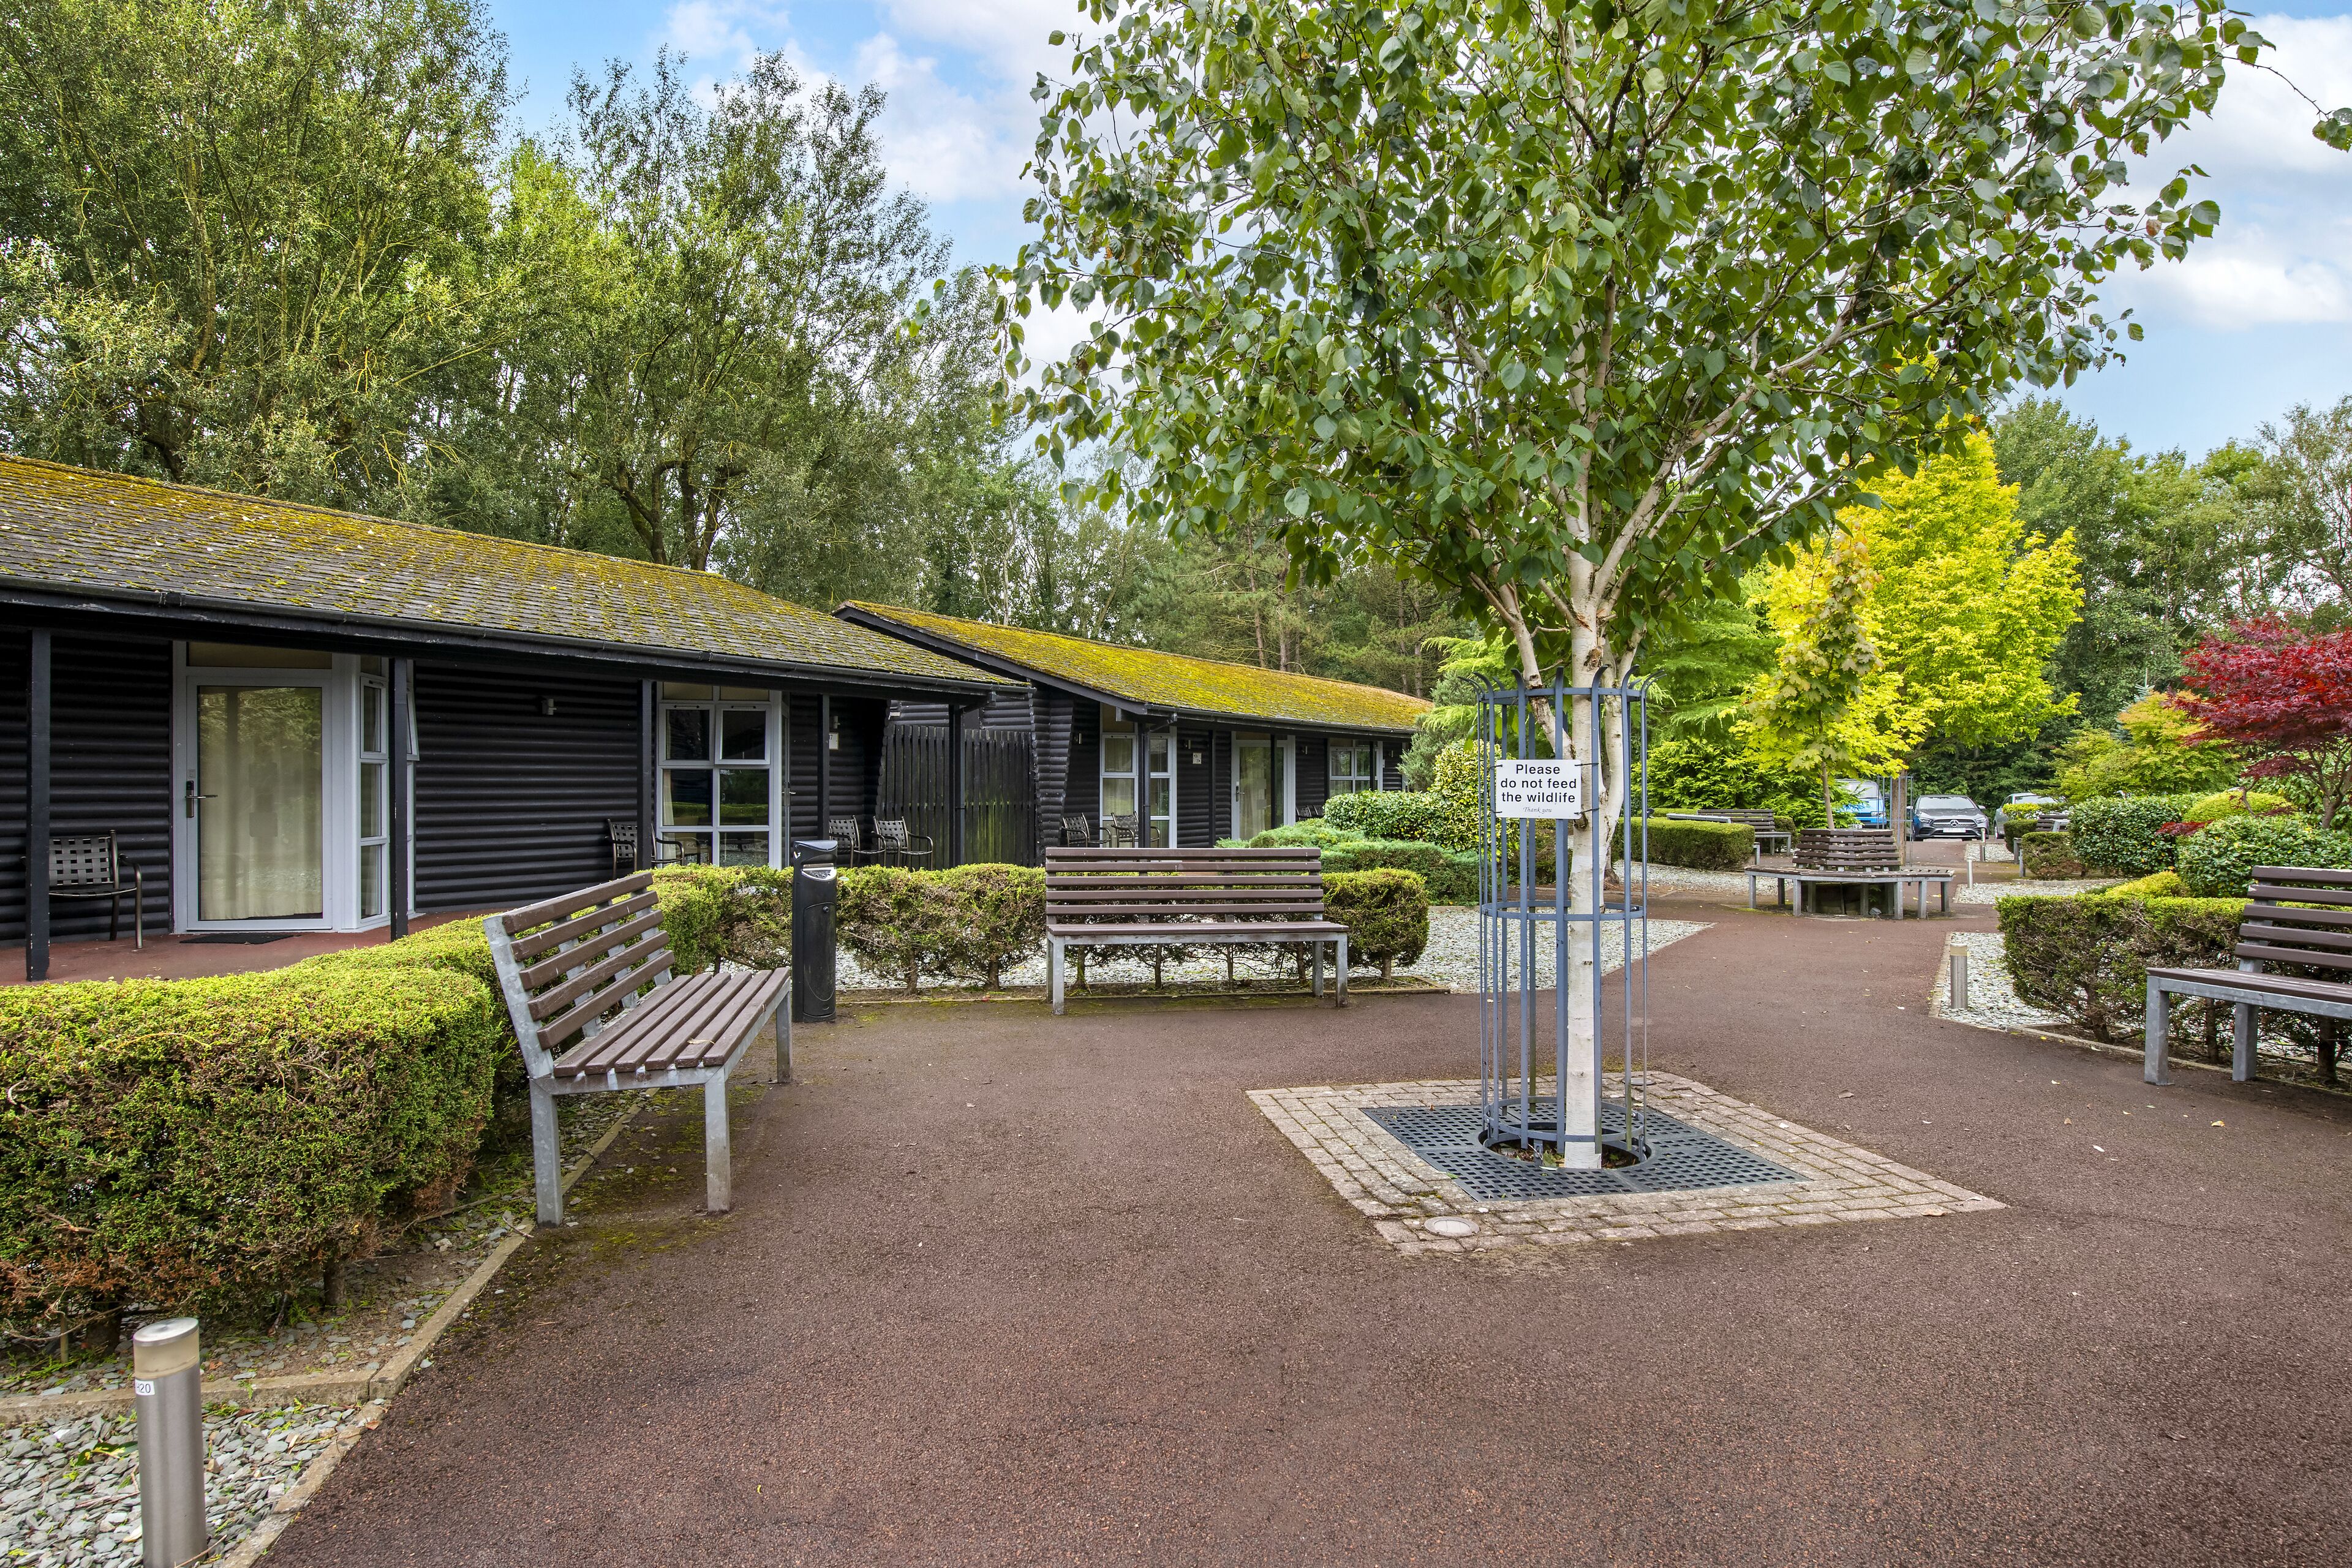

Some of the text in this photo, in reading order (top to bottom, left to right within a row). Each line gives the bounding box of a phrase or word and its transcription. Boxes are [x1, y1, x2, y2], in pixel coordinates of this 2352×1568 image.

[1517, 764, 1560, 774] Please
[1501, 778, 1576, 788] do not feed
[1502, 792, 1575, 802] the wildlife
